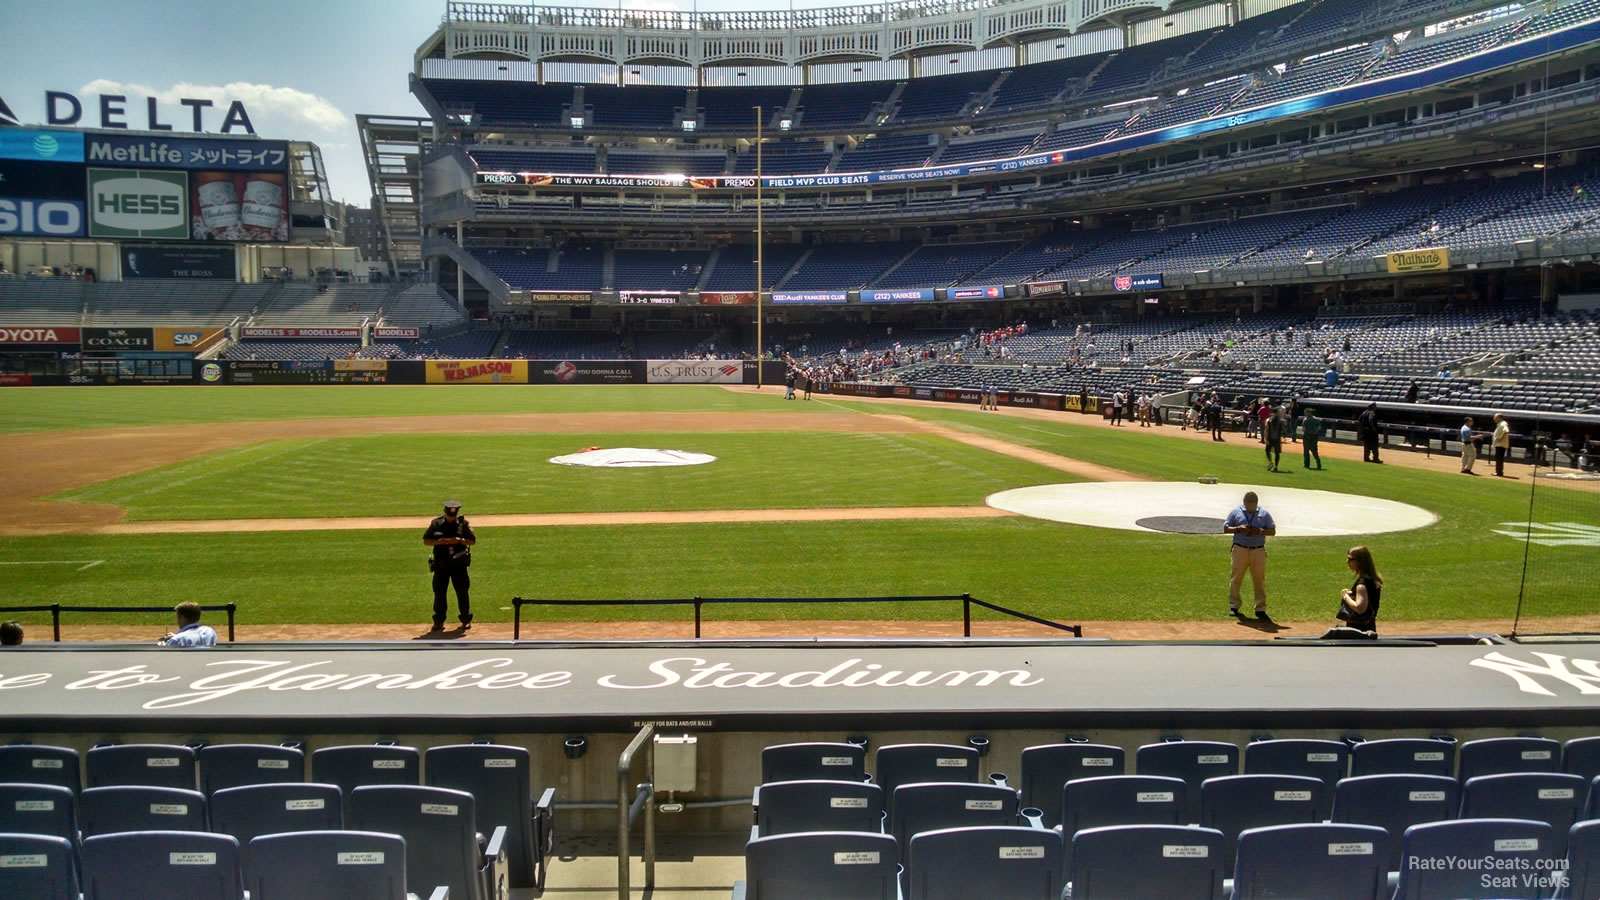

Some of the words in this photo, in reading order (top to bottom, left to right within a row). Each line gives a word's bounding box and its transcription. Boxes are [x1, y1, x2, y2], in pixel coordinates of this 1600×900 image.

[45, 90, 255, 134] DELTA
[89, 142, 183, 163] MetLife
[189, 148, 285, 165] メットライフ
[1001, 162, 1018, 170] (212)
[1019, 157, 1048, 167] YANKEES
[484, 174, 517, 183] PREMIO
[879, 173, 907, 181] RESERVE
[924, 170, 943, 178] SEATS
[944, 168, 961, 177] NOW!
[596, 178, 634, 186] SAUSAGE
[724, 178, 755, 187] PREMIO
[796, 178, 815, 186] MVP
[816, 176, 840, 185] CLUB
[842, 175, 869, 184] SEATS
[98, 193, 180, 215] HESS
[1392, 250, 1440, 266] Nathan's
[172, 269, 189, 277] THE
[191, 269, 213, 277] BOSS
[874, 292, 890, 300] (212)
[891, 291, 921, 299] YANKEES
[300, 329, 357, 337] MODELLS.com
[378, 329, 415, 337] MODELL'S
[88, 337, 148, 345] COACH
[174, 334, 199, 345] SAP
[651, 367, 673, 377] U.S.
[677, 367, 716, 377] TRUST
[961, 391, 970, 399] Audi
[64, 665, 180, 690] to
[142, 657, 571, 710] Yankee
[596, 657, 1045, 689] Stadium
